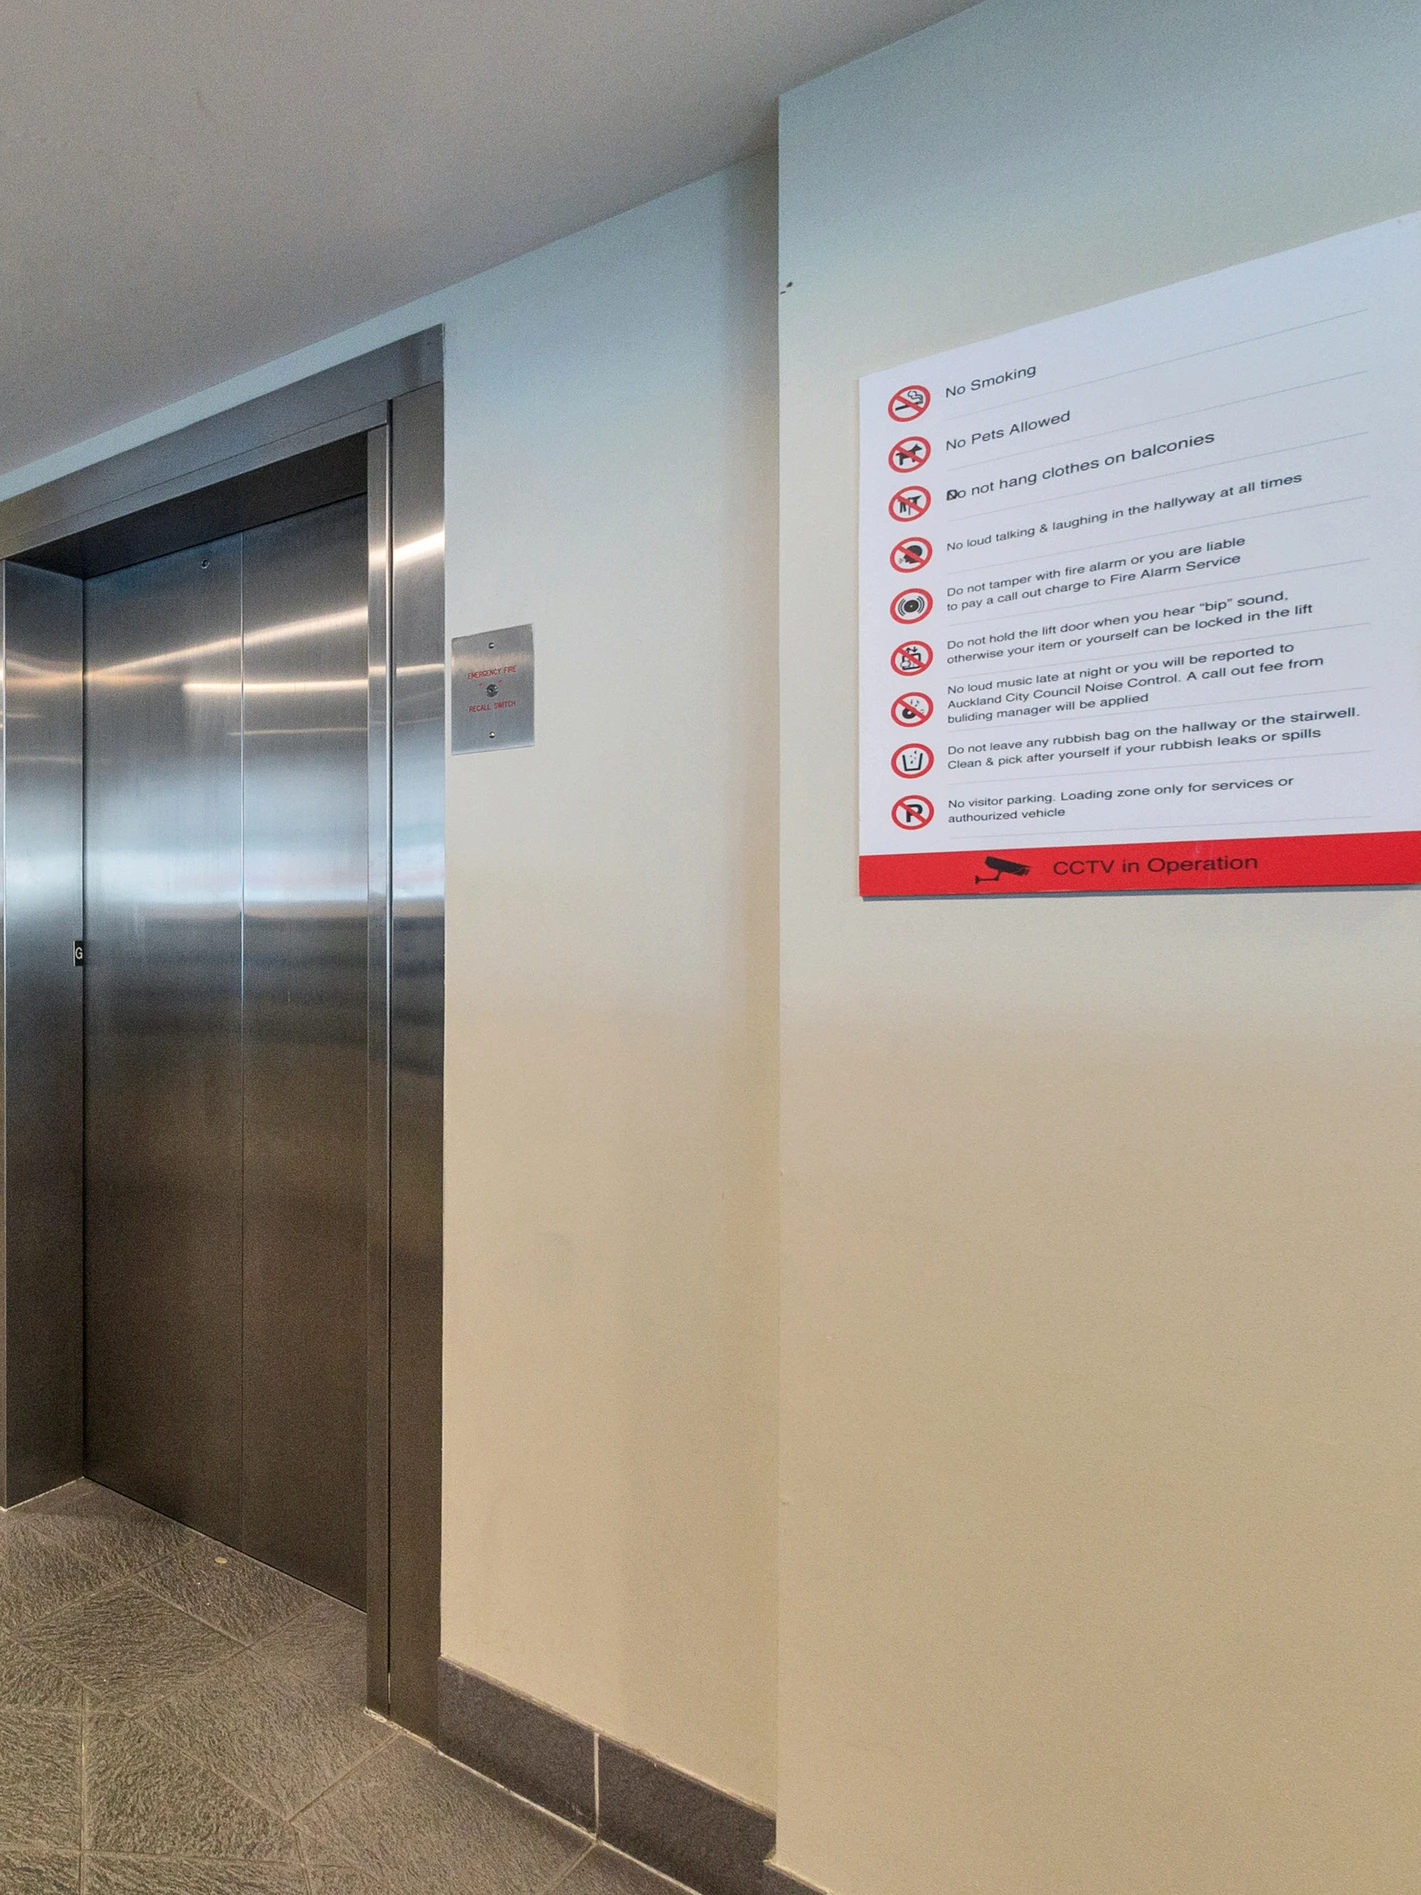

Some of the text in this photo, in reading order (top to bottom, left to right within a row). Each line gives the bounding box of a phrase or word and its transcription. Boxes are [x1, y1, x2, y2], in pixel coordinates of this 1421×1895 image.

[945, 365, 1037, 398] No Smoking
[945, 410, 1071, 451] No Pets Allowed
[971, 481, 995, 496] not
[999, 473, 1038, 490] hang
[1041, 459, 1100, 480] clothes
[1104, 453, 1126, 466] on
[1131, 433, 1215, 461] balconies
[946, 474, 1303, 551] No loud talking & laughing in the hallyway at all times
[946, 537, 1246, 597] Do not tamper with fire alarm or you are liable
[946, 555, 1241, 612] to pay a call out charge to Fire Alarm Service
[946, 603, 1313, 665] otherwise your item or yourself can be locked in the lift
[947, 640, 964, 650] Do
[967, 636, 986, 647] not
[989, 631, 1015, 644] hold
[1018, 629, 1039, 639] the
[1041, 625, 1057, 636] lift
[1059, 621, 1090, 633] door
[1093, 615, 1130, 628] when
[1133, 611, 1159, 625] you
[1162, 605, 1196, 618] hear
[947, 643, 1295, 695] No loud music late at night or you will be reported to
[947, 657, 1324, 709] Auckland City Council Noise Control. A call out fee from
[947, 692, 1149, 724] buliding manager will be applied
[947, 706, 1360, 756] Do not leave any rubbish bag on the hallway or the stairwell.
[947, 728, 1322, 770] Clean & pick after yourself if your rubbish leaks or spills
[948, 777, 1294, 809] No visitor parking. Loading zone only for services or
[948, 807, 1066, 824] authourized vehicle
[1053, 855, 1259, 876] CCTV in Operation
[75, 946, 83, 960] G
